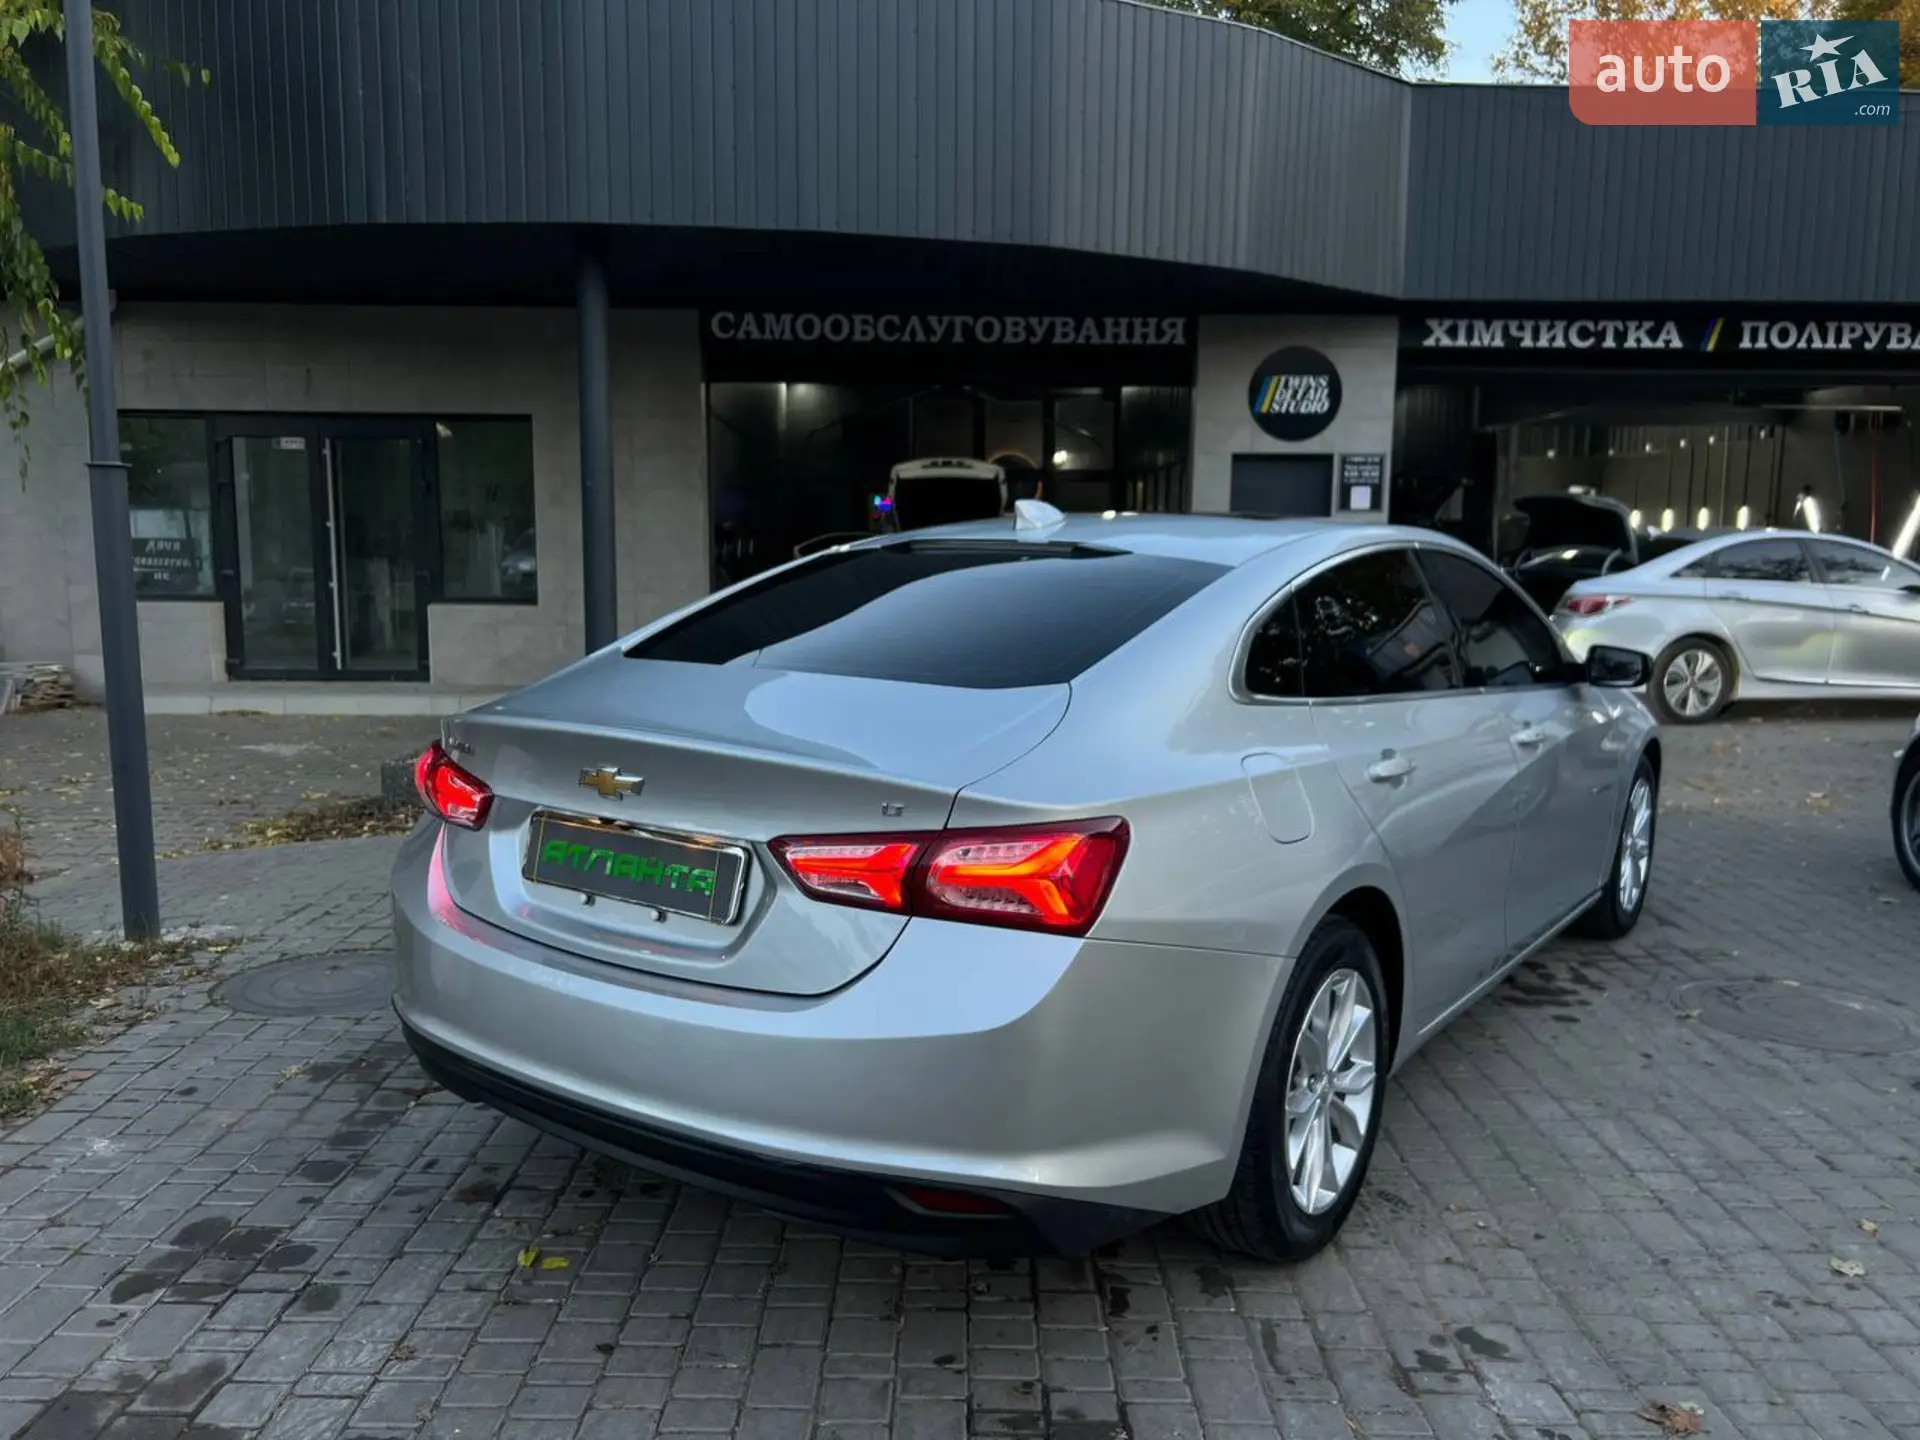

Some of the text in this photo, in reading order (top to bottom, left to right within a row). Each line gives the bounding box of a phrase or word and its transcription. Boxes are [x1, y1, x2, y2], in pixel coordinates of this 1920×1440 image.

[710, 311, 1187, 346] САМООБСЛУГОВУВАННЯ
[1422, 318, 1684, 350] ХІМЧИСТКА
[1270, 400, 1330, 414] STUDIO
